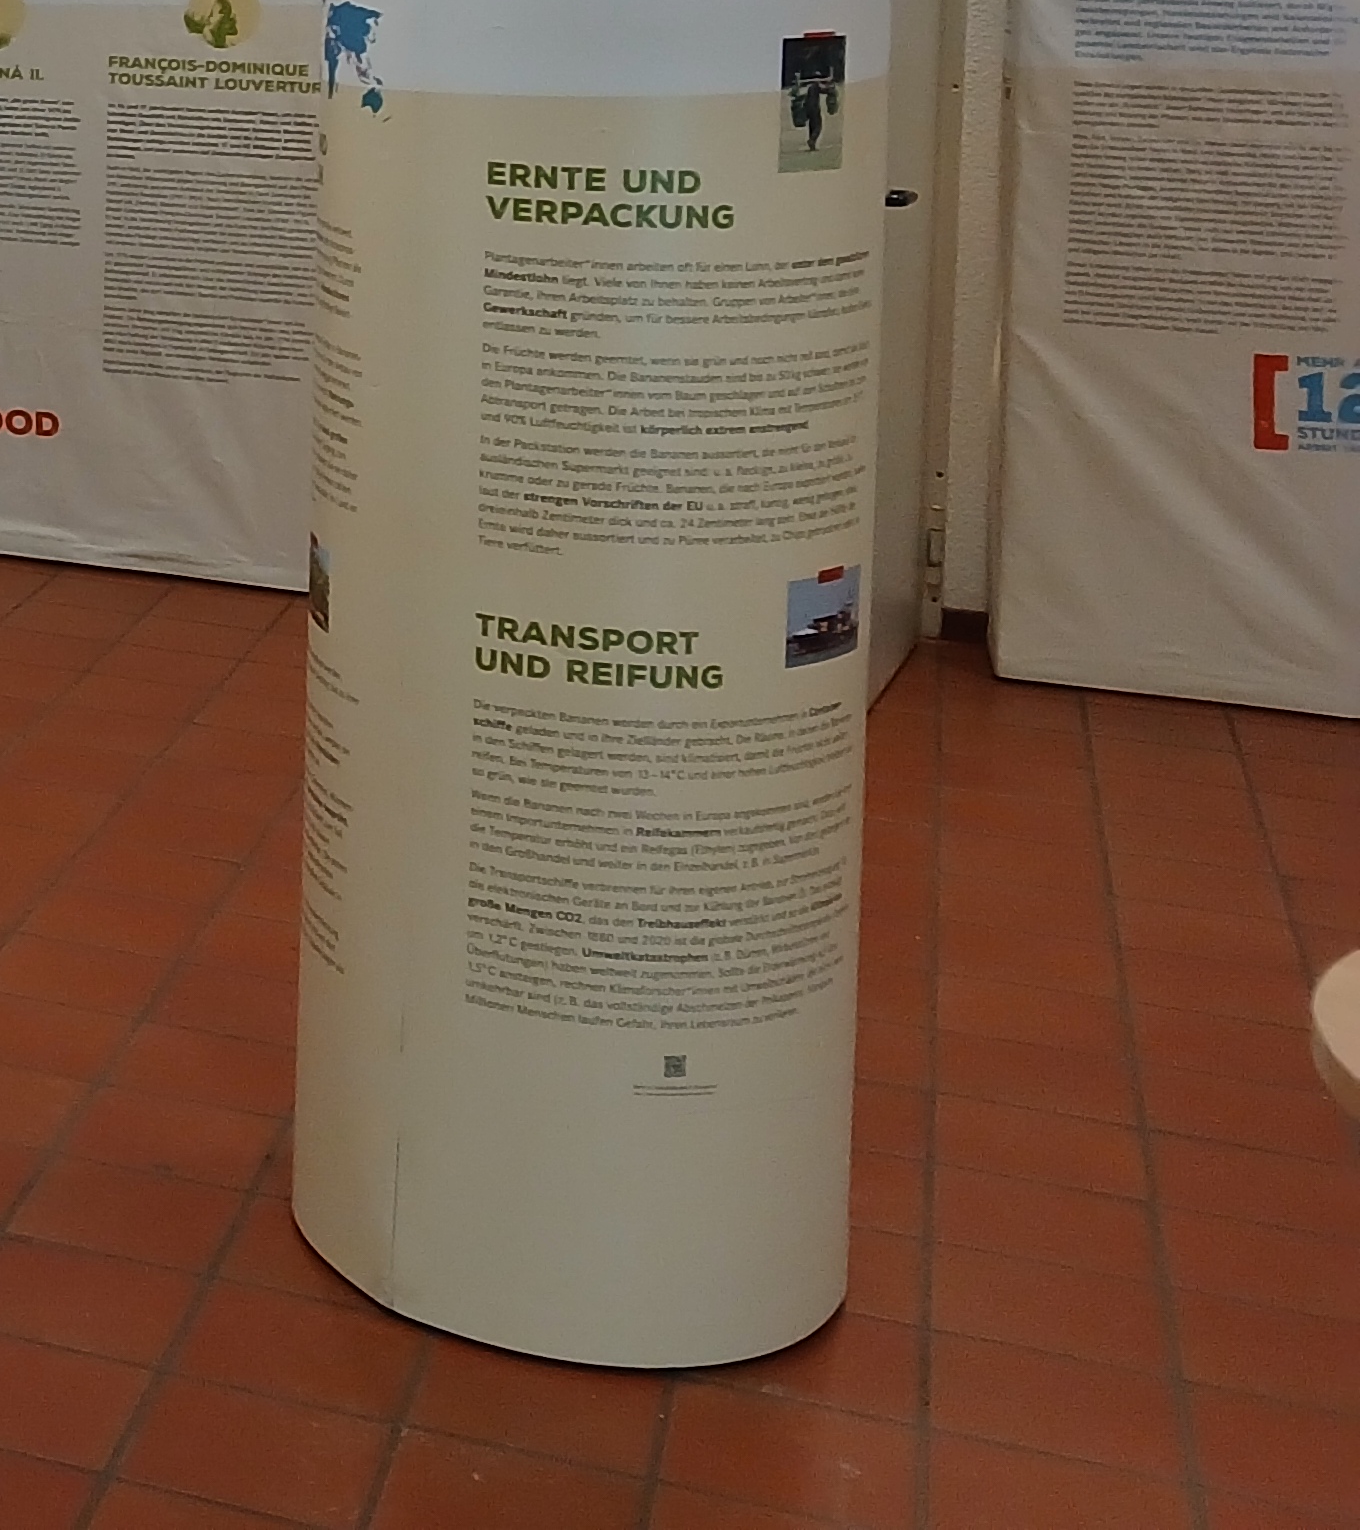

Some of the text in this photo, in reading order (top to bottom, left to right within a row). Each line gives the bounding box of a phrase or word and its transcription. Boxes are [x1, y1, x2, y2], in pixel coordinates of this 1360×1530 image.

[108, 54, 310, 79] FRANÇOIS-DOMINIQUE
[108, 71, 322, 95] TOUSSAINT LOUVERTUR
[486, 160, 702, 195] ERNTE UND
[485, 195, 736, 230] VERPACKUNG
[475, 612, 700, 657] TRANSPORT
[475, 646, 724, 690] UND REIFUNG
